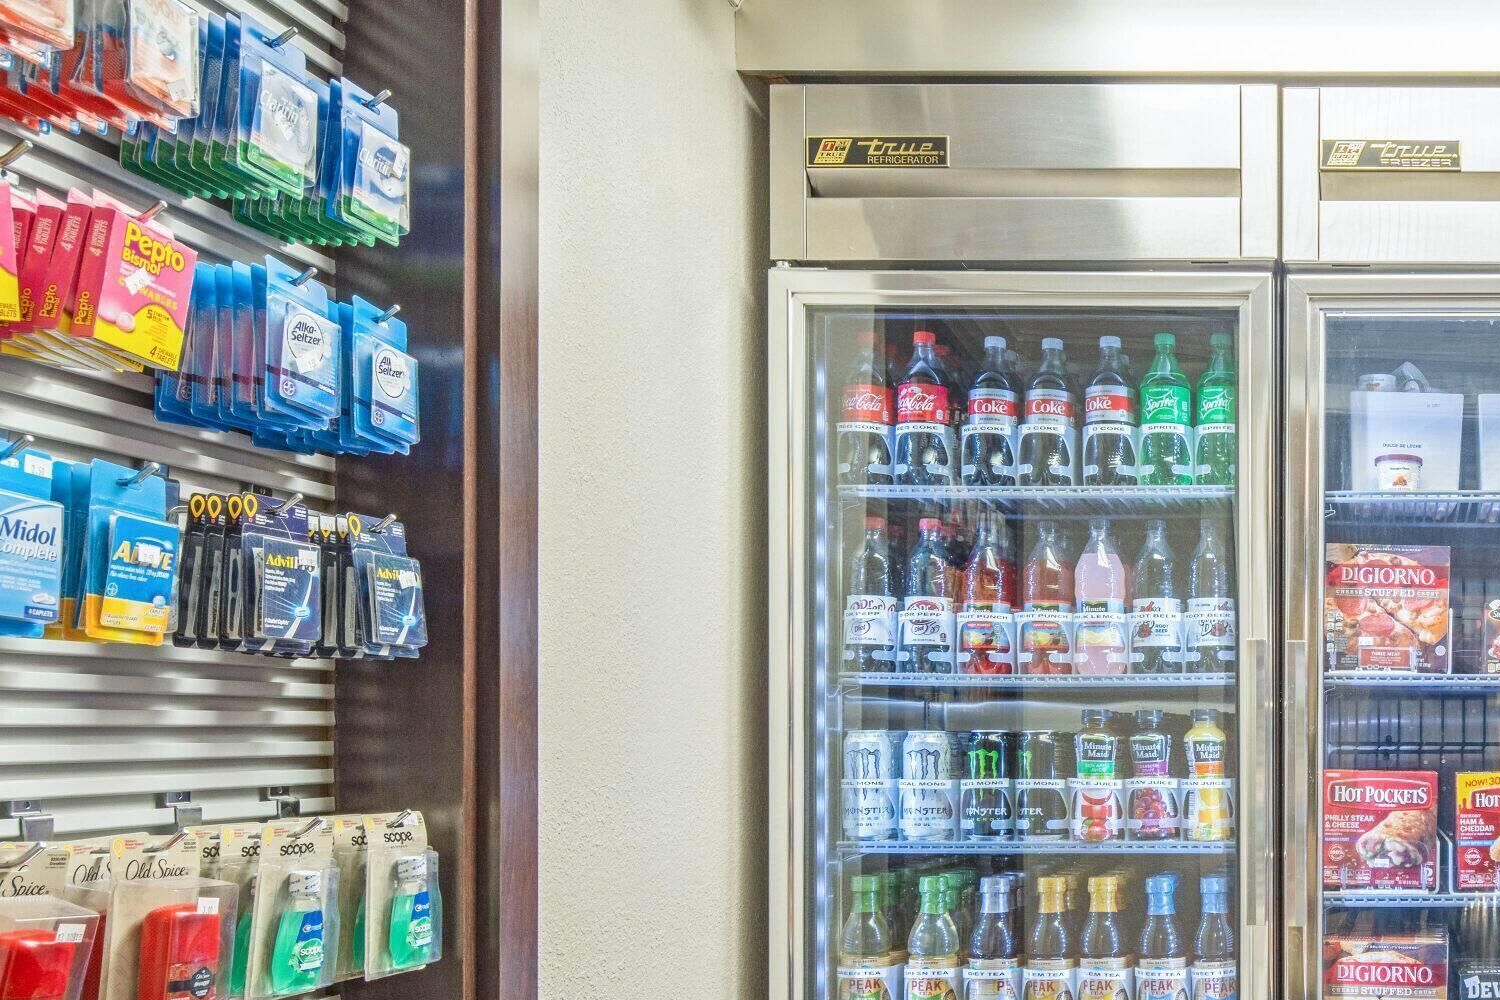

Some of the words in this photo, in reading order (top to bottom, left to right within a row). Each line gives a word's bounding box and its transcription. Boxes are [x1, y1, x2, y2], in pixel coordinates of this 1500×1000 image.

[858, 139, 939, 155] true
[867, 156, 939, 164] REFRIGERATOR
[1380, 159, 1451, 167] FREEZER
[124, 221, 185, 272] Pepto
[121, 247, 162, 276] Bismol
[39, 284, 57, 317] Pepto
[75, 291, 90, 325] Pepto
[293, 320, 317, 335] Alka-
[291, 331, 321, 346] Seltzer
[378, 364, 404, 379] Seltzer
[974, 400, 1007, 414] Coke
[1032, 400, 1065, 414] Coke
[1086, 397, 1111, 410] Coke
[1147, 398, 1176, 411] Sprite
[0, 515, 56, 546] Midol
[266, 553, 294, 569] Advil
[377, 568, 400, 581] Advil
[1364, 588, 1415, 597] STUFFED
[1084, 742, 1111, 750] Minute
[1133, 742, 1161, 750] Minute
[1087, 750, 1108, 758] Maid
[1136, 750, 1158, 758] Maid
[1200, 751, 1219, 759] Maid
[1465, 780, 1487, 788] NOW!
[384, 830, 413, 844] scope
[280, 842, 314, 858] scope
[73, 864, 98, 884] Old
[126, 860, 151, 880] Old
[153, 858, 186, 879] Spice
[9, 875, 48, 898] Spice
[849, 979, 881, 990] PEAK
[911, 979, 942, 991] PEAK
[1083, 980, 1113, 991] PEAK
[1144, 980, 1173, 990] PEAK
[1204, 980, 1236, 993] PEAK
[1361, 987, 1412, 996] STUFFED
